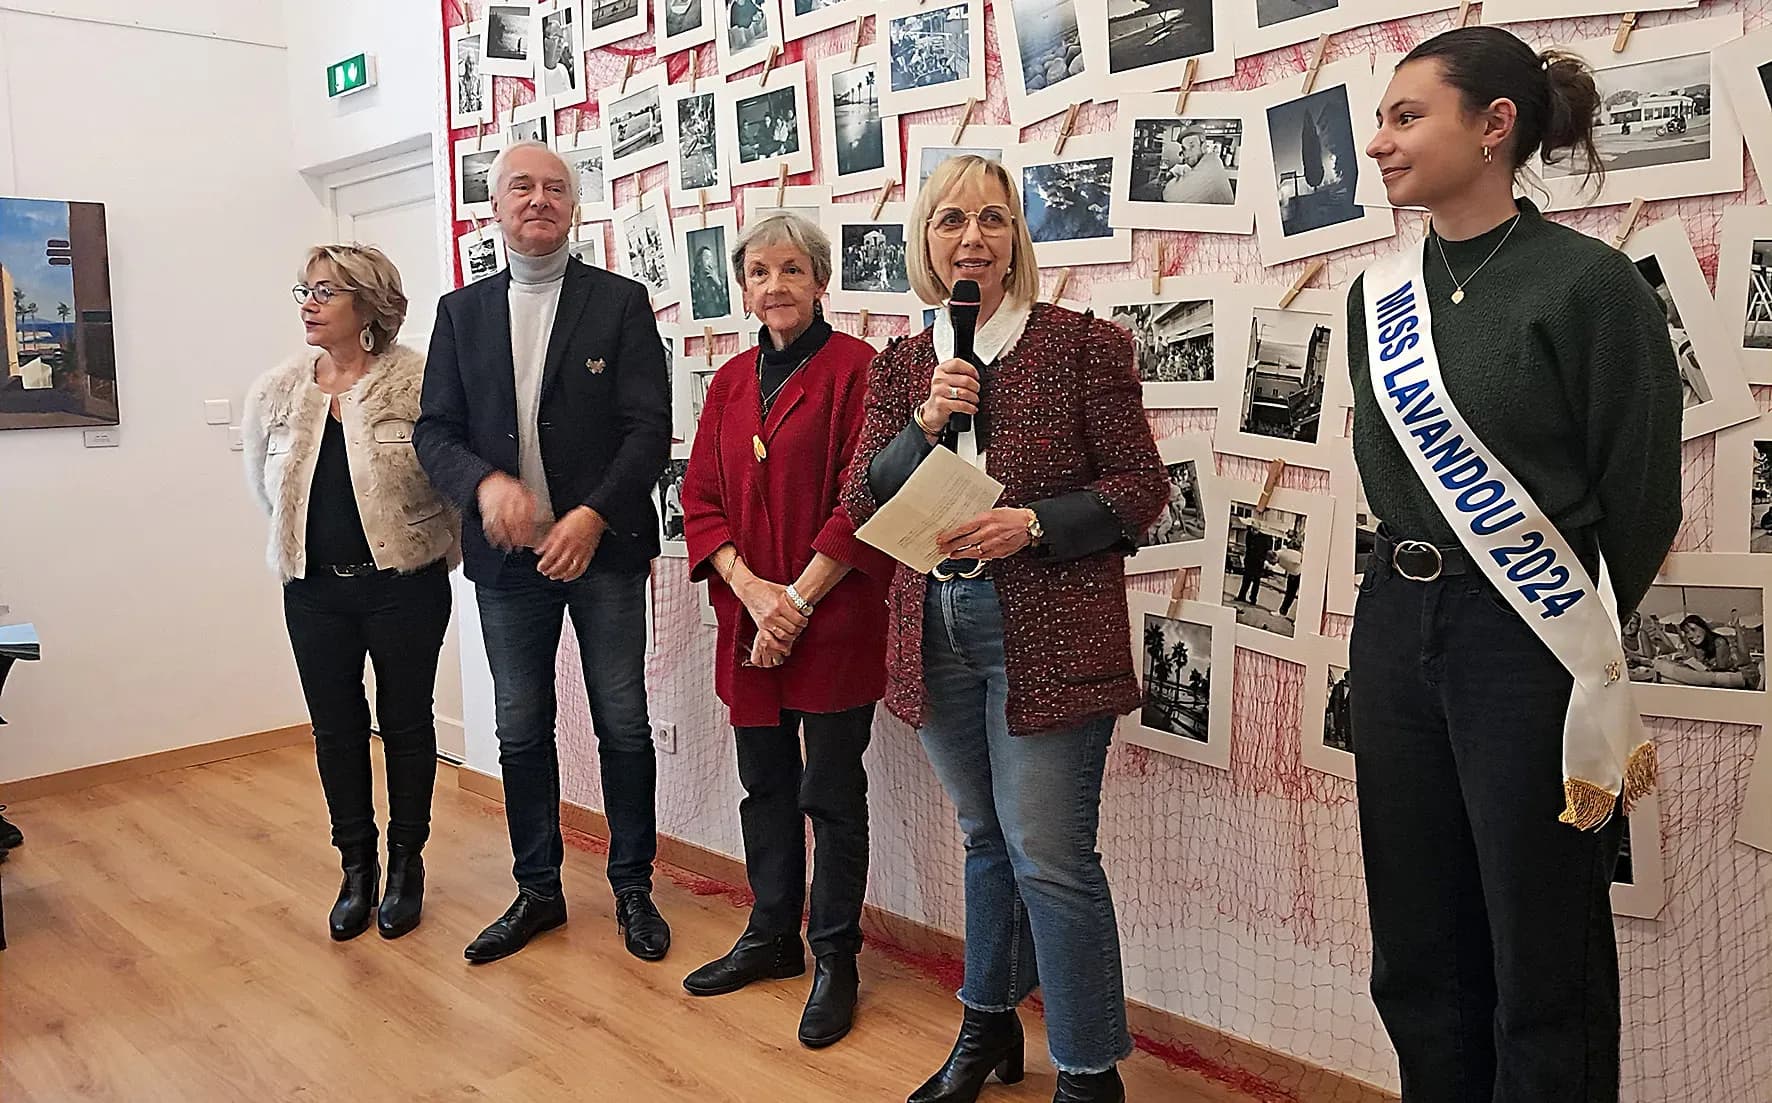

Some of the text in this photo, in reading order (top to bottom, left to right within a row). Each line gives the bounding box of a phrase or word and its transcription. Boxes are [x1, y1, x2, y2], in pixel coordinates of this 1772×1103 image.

[1376, 280, 1586, 620] MISS LAVANDOU 2024
